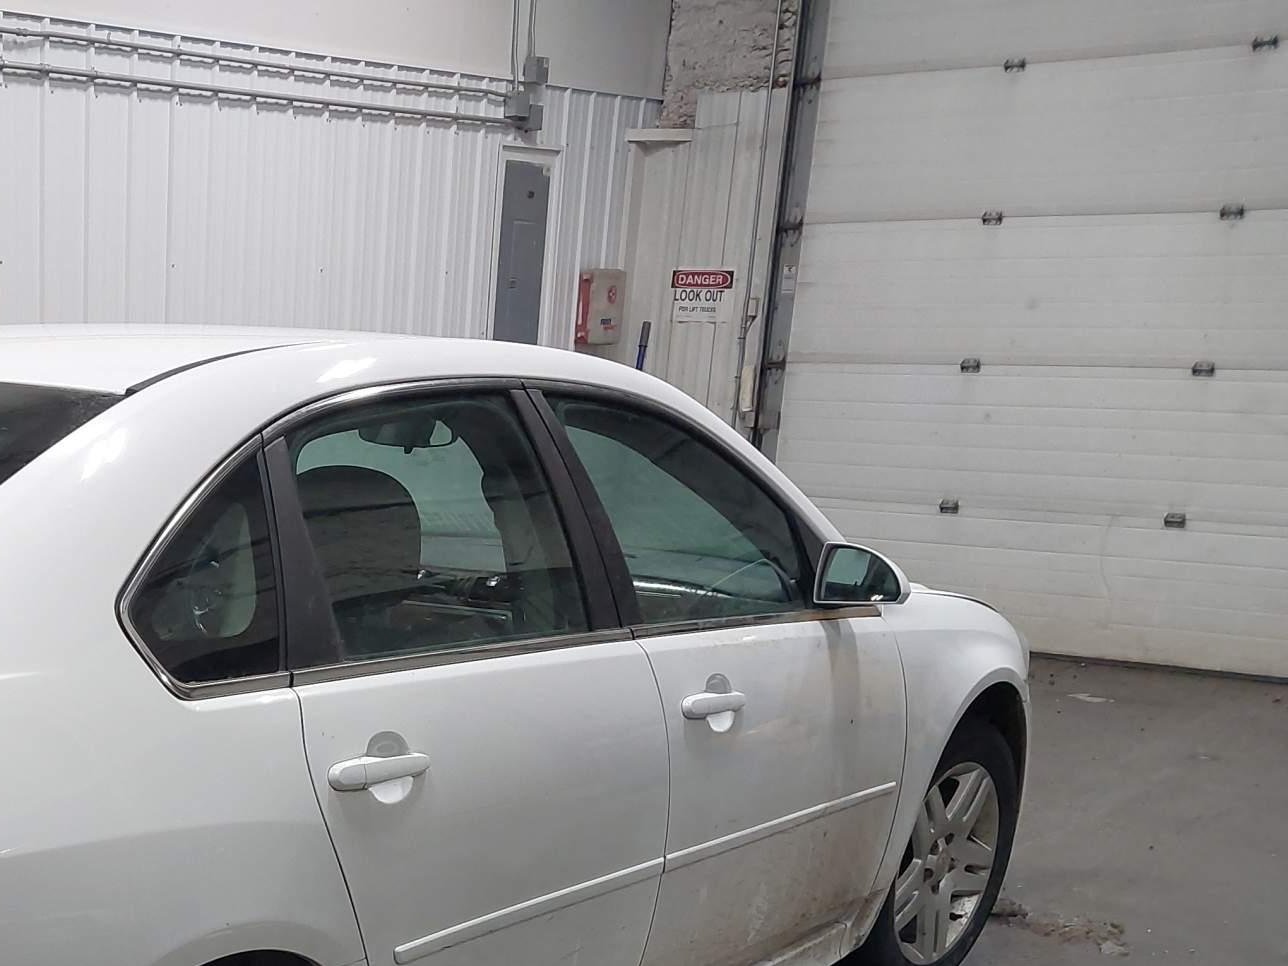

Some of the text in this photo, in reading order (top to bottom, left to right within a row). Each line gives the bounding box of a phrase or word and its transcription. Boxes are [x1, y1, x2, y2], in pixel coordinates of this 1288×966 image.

[678, 274, 724, 285] DANGER
[674, 289, 725, 302] LOOK OUT
